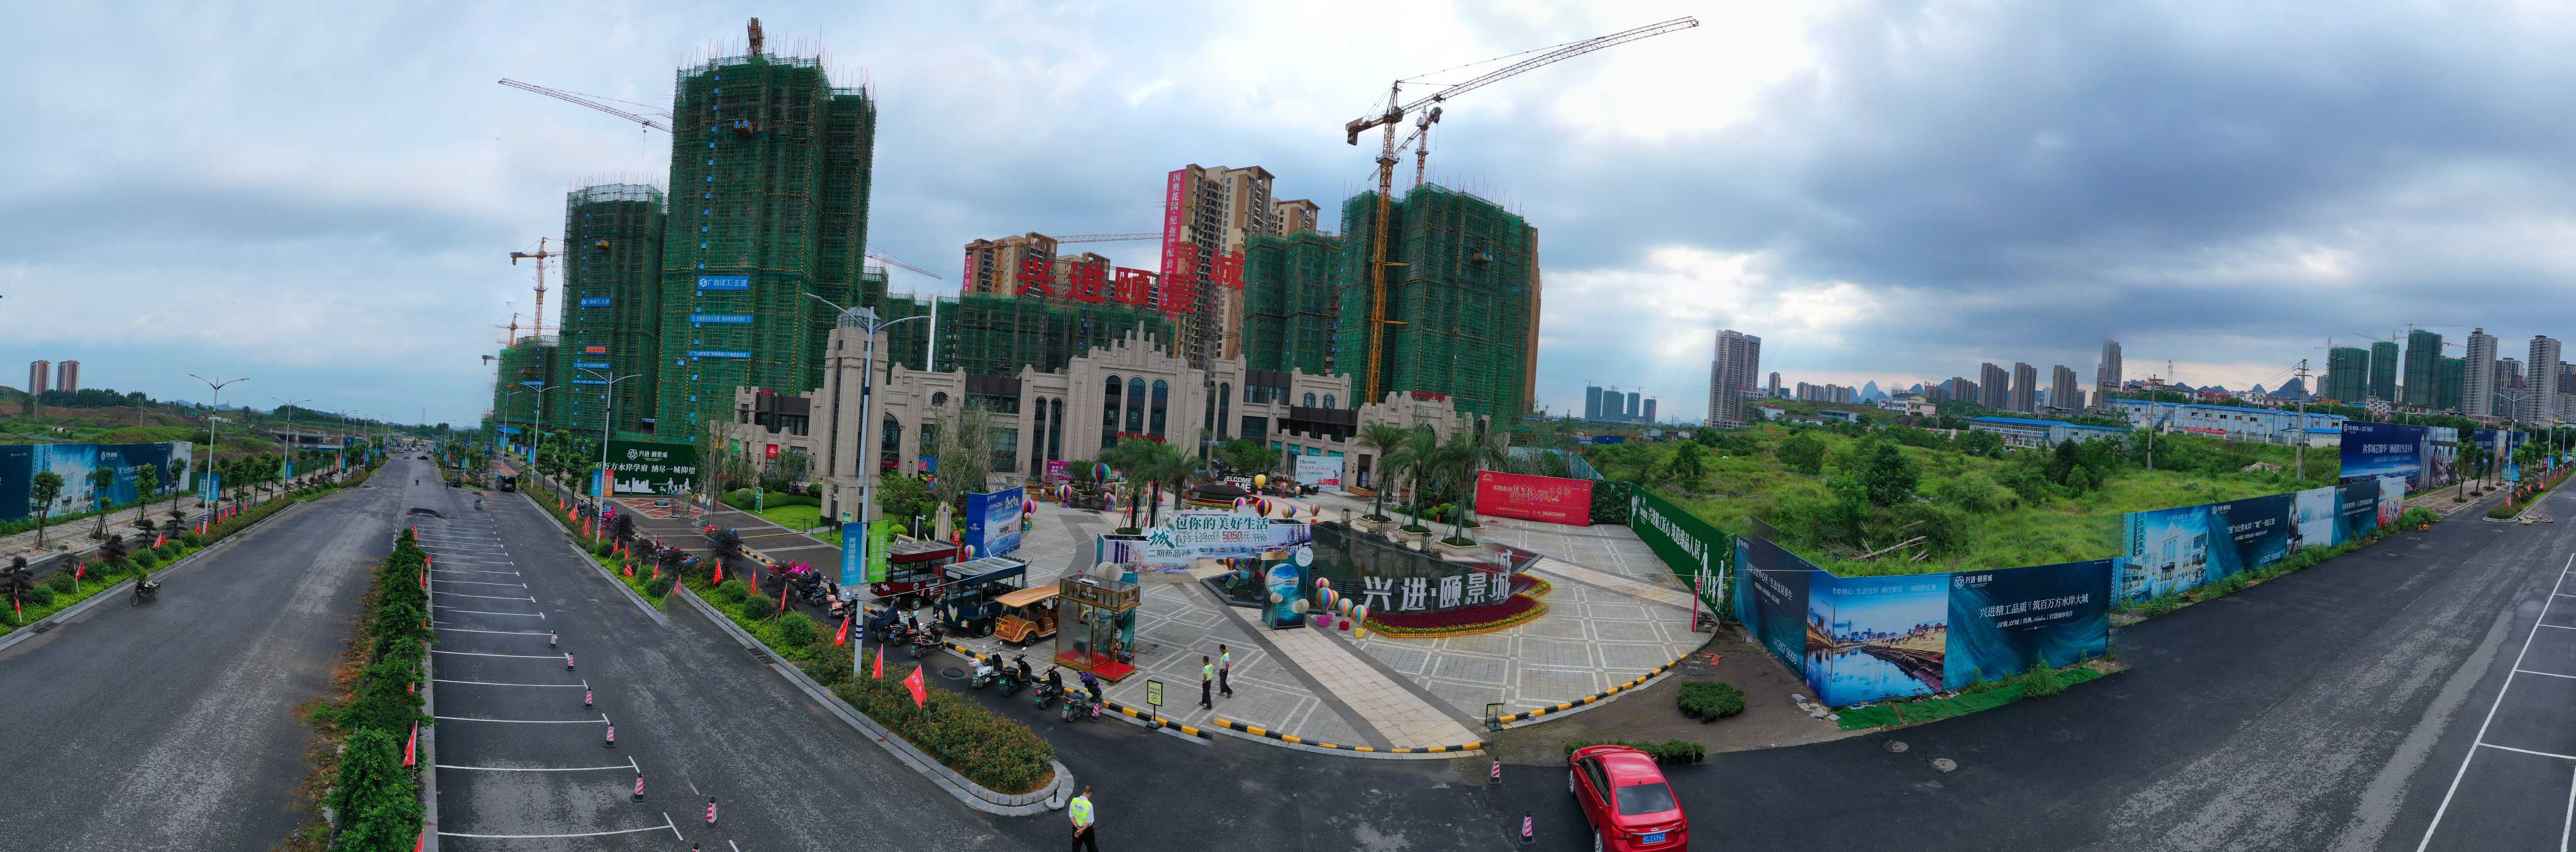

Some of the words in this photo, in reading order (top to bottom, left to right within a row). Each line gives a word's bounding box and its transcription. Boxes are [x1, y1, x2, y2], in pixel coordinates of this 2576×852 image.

[1175, 517, 1269, 530] 包你的美好生活
[1979, 602, 2027, 619] 兴进精工品质
[2032, 593, 2089, 612] 筑百万方水岸大城
